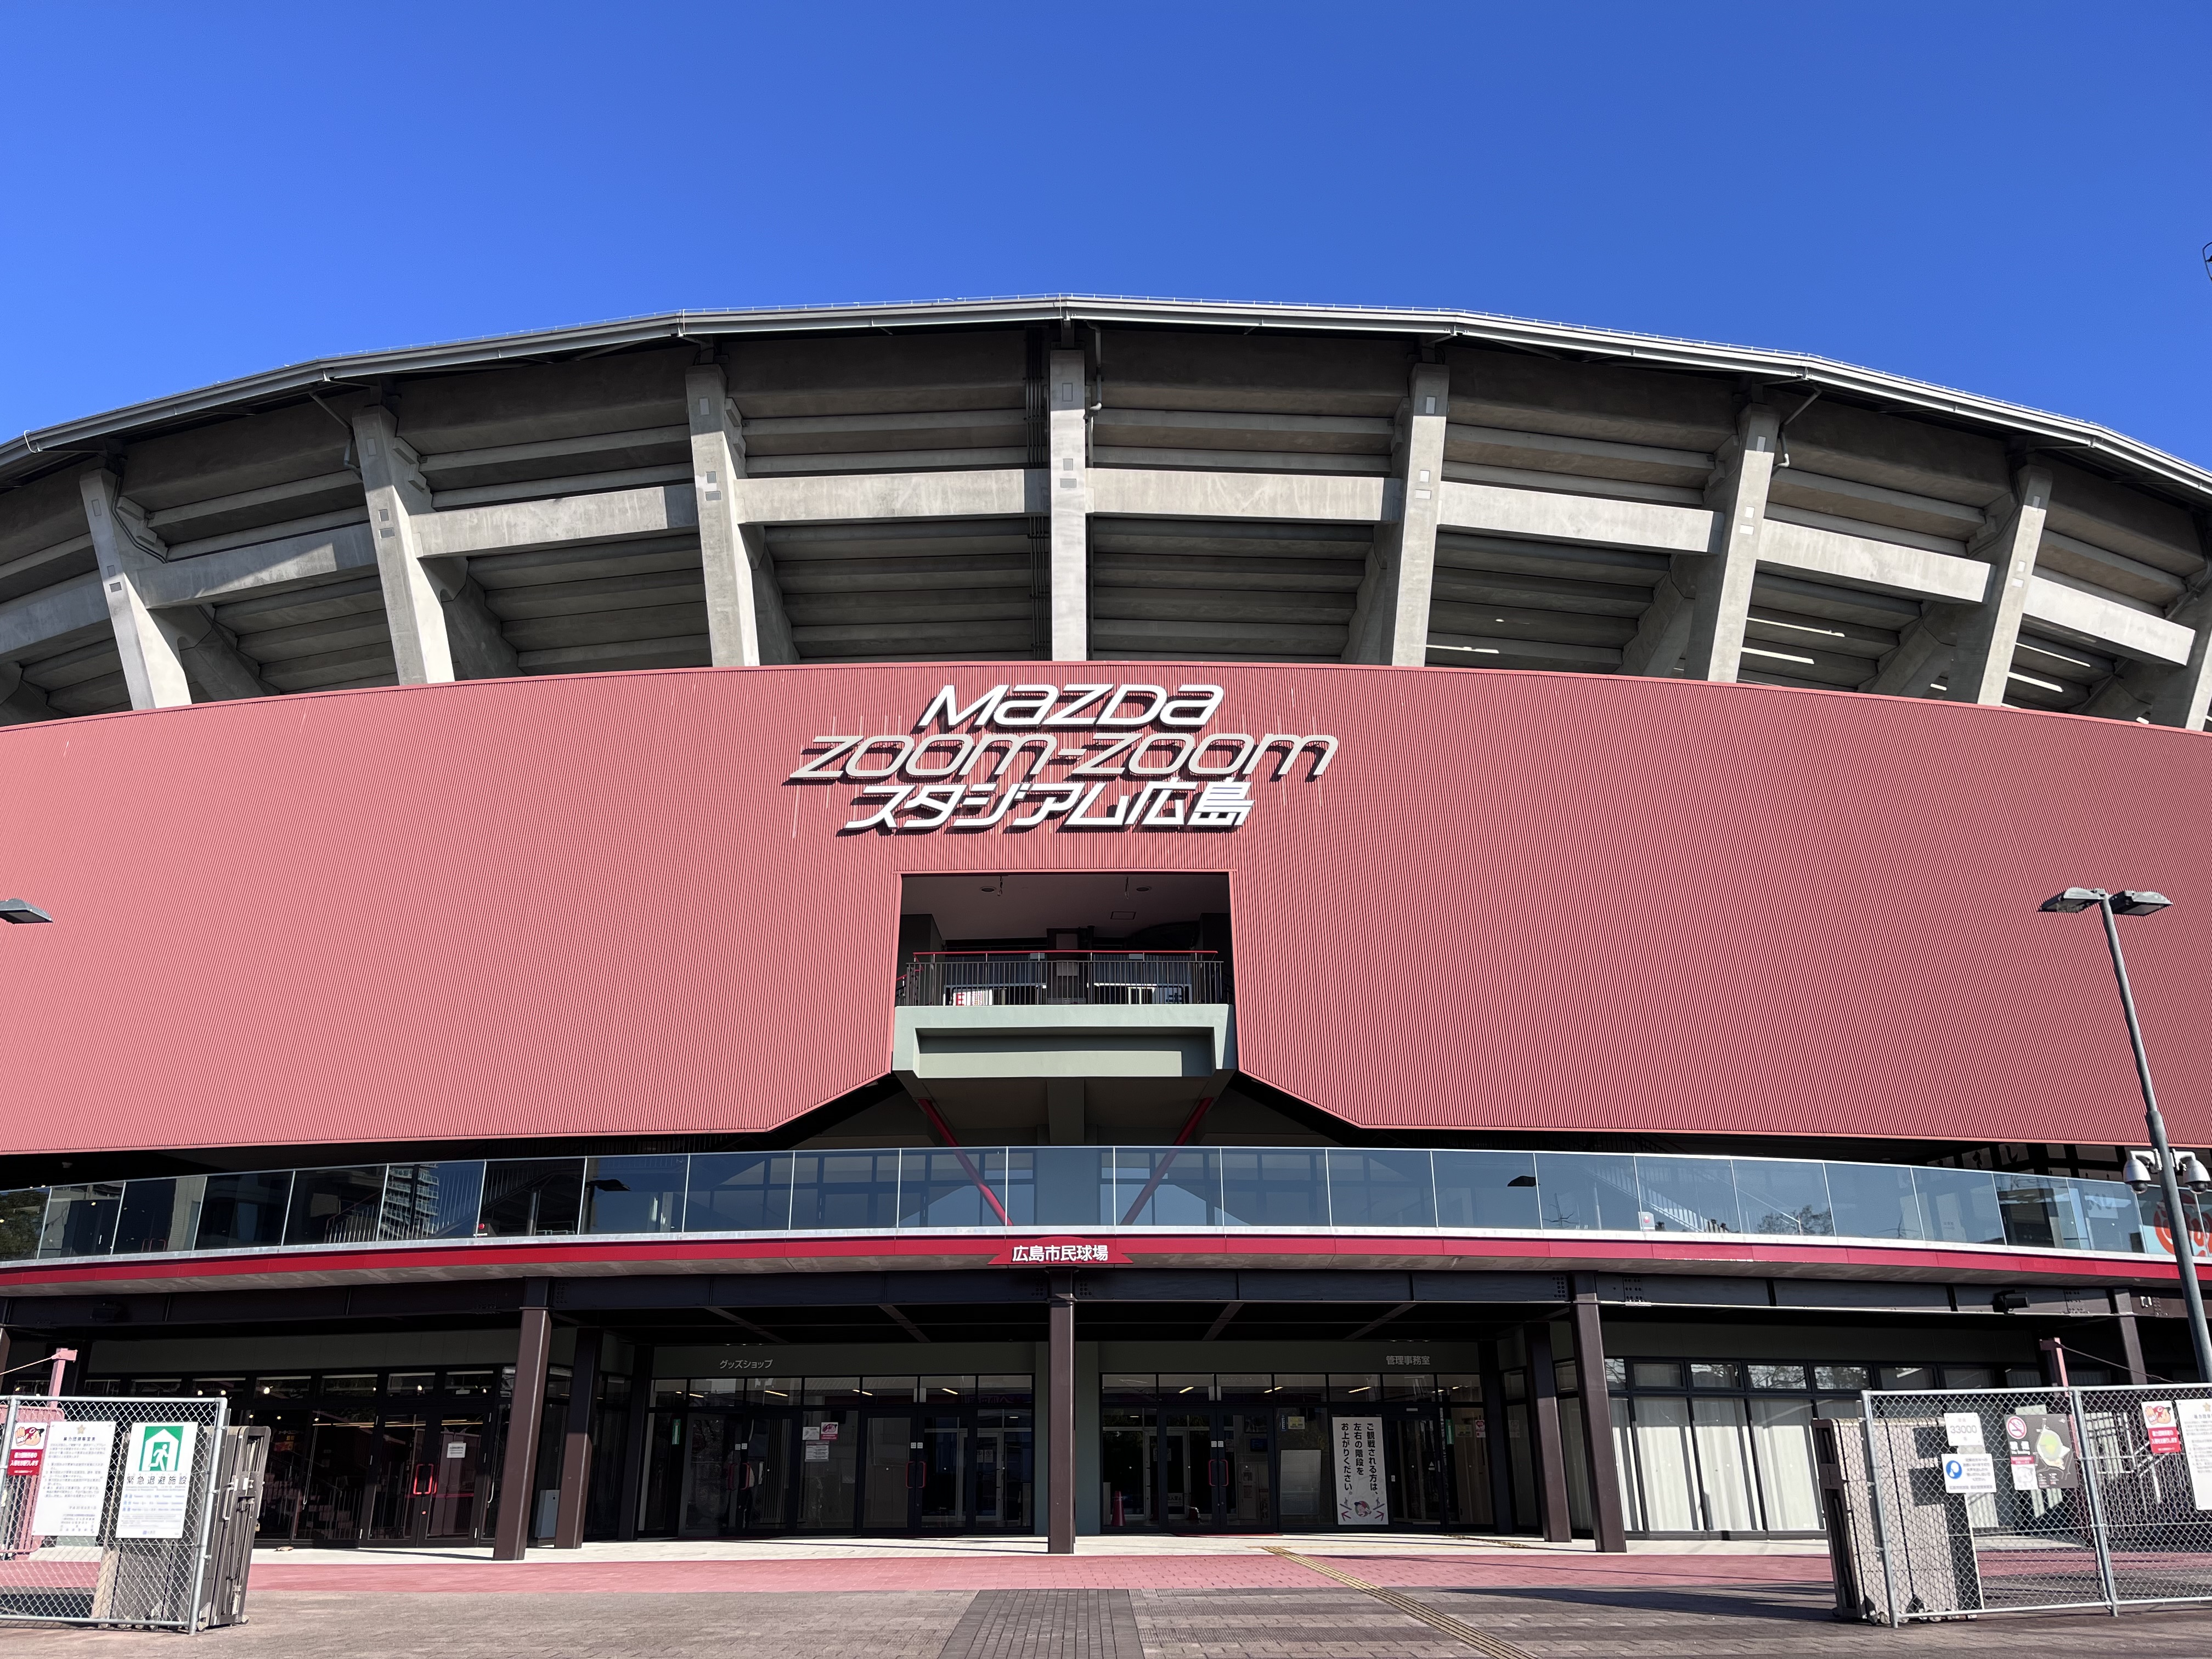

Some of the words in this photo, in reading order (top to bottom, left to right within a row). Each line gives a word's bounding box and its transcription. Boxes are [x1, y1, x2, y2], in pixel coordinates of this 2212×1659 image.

[845, 777, 1256, 831] スタジアム広島
[1012, 1245, 1109, 1262] 広島市民球場
[719, 1359, 773, 1369] グッズショップ
[1386, 1355, 1431, 1365] 管理事務室
[1950, 1425, 1978, 1434] 33000
[1353, 1422, 1364, 1476] 左右の階段を
[1341, 1423, 1352, 1496] お上がりください。
[1367, 1423, 1378, 1496] ご観戦される方は、
[126, 1476, 188, 1485] 緊急退避施設
